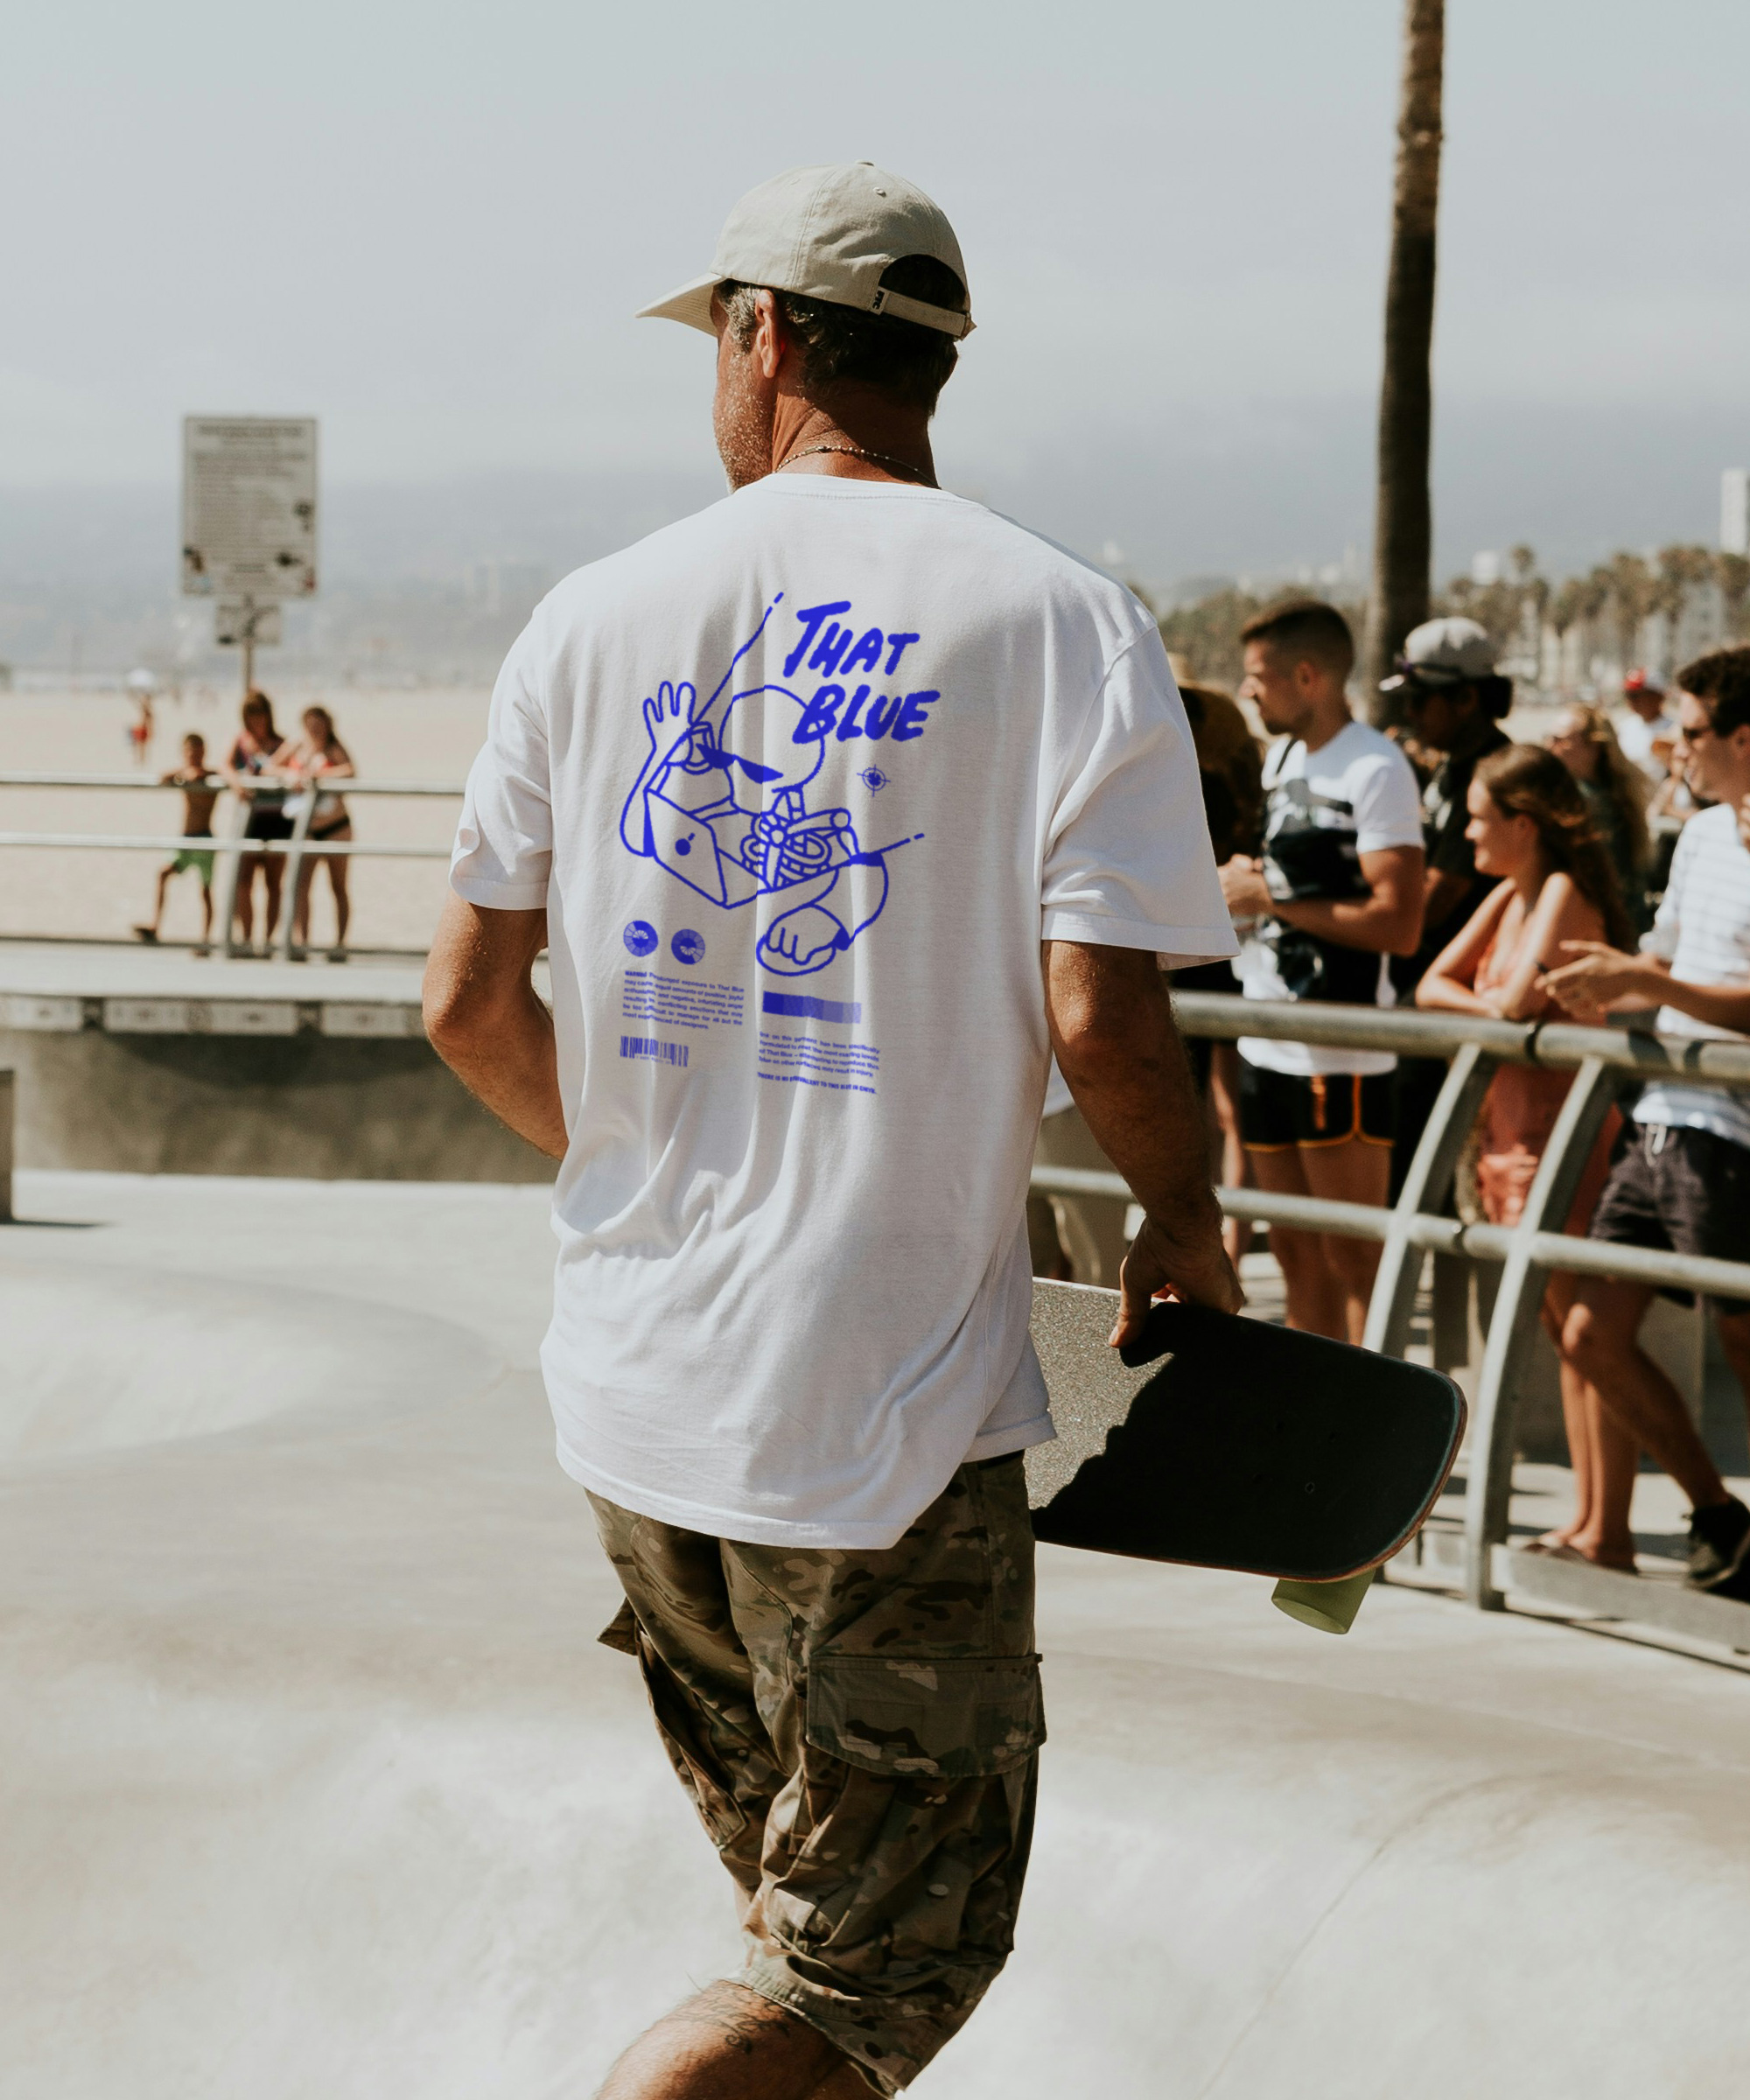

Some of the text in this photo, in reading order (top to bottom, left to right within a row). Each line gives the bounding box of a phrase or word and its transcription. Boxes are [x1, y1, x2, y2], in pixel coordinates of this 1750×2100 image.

[783, 600, 920, 678] THAT
[792, 683, 941, 745] BLUE
[649, 972, 679, 984] Prolonged
[658, 1001, 687, 1011] conflicting
[638, 1014, 672, 1024] experienced
[799, 1053, 831, 1064] attempting
[861, 1053, 878, 1061] levels
[796, 1060, 821, 1070] surfaces
[790, 1075, 819, 1086] EQUIVALENT
